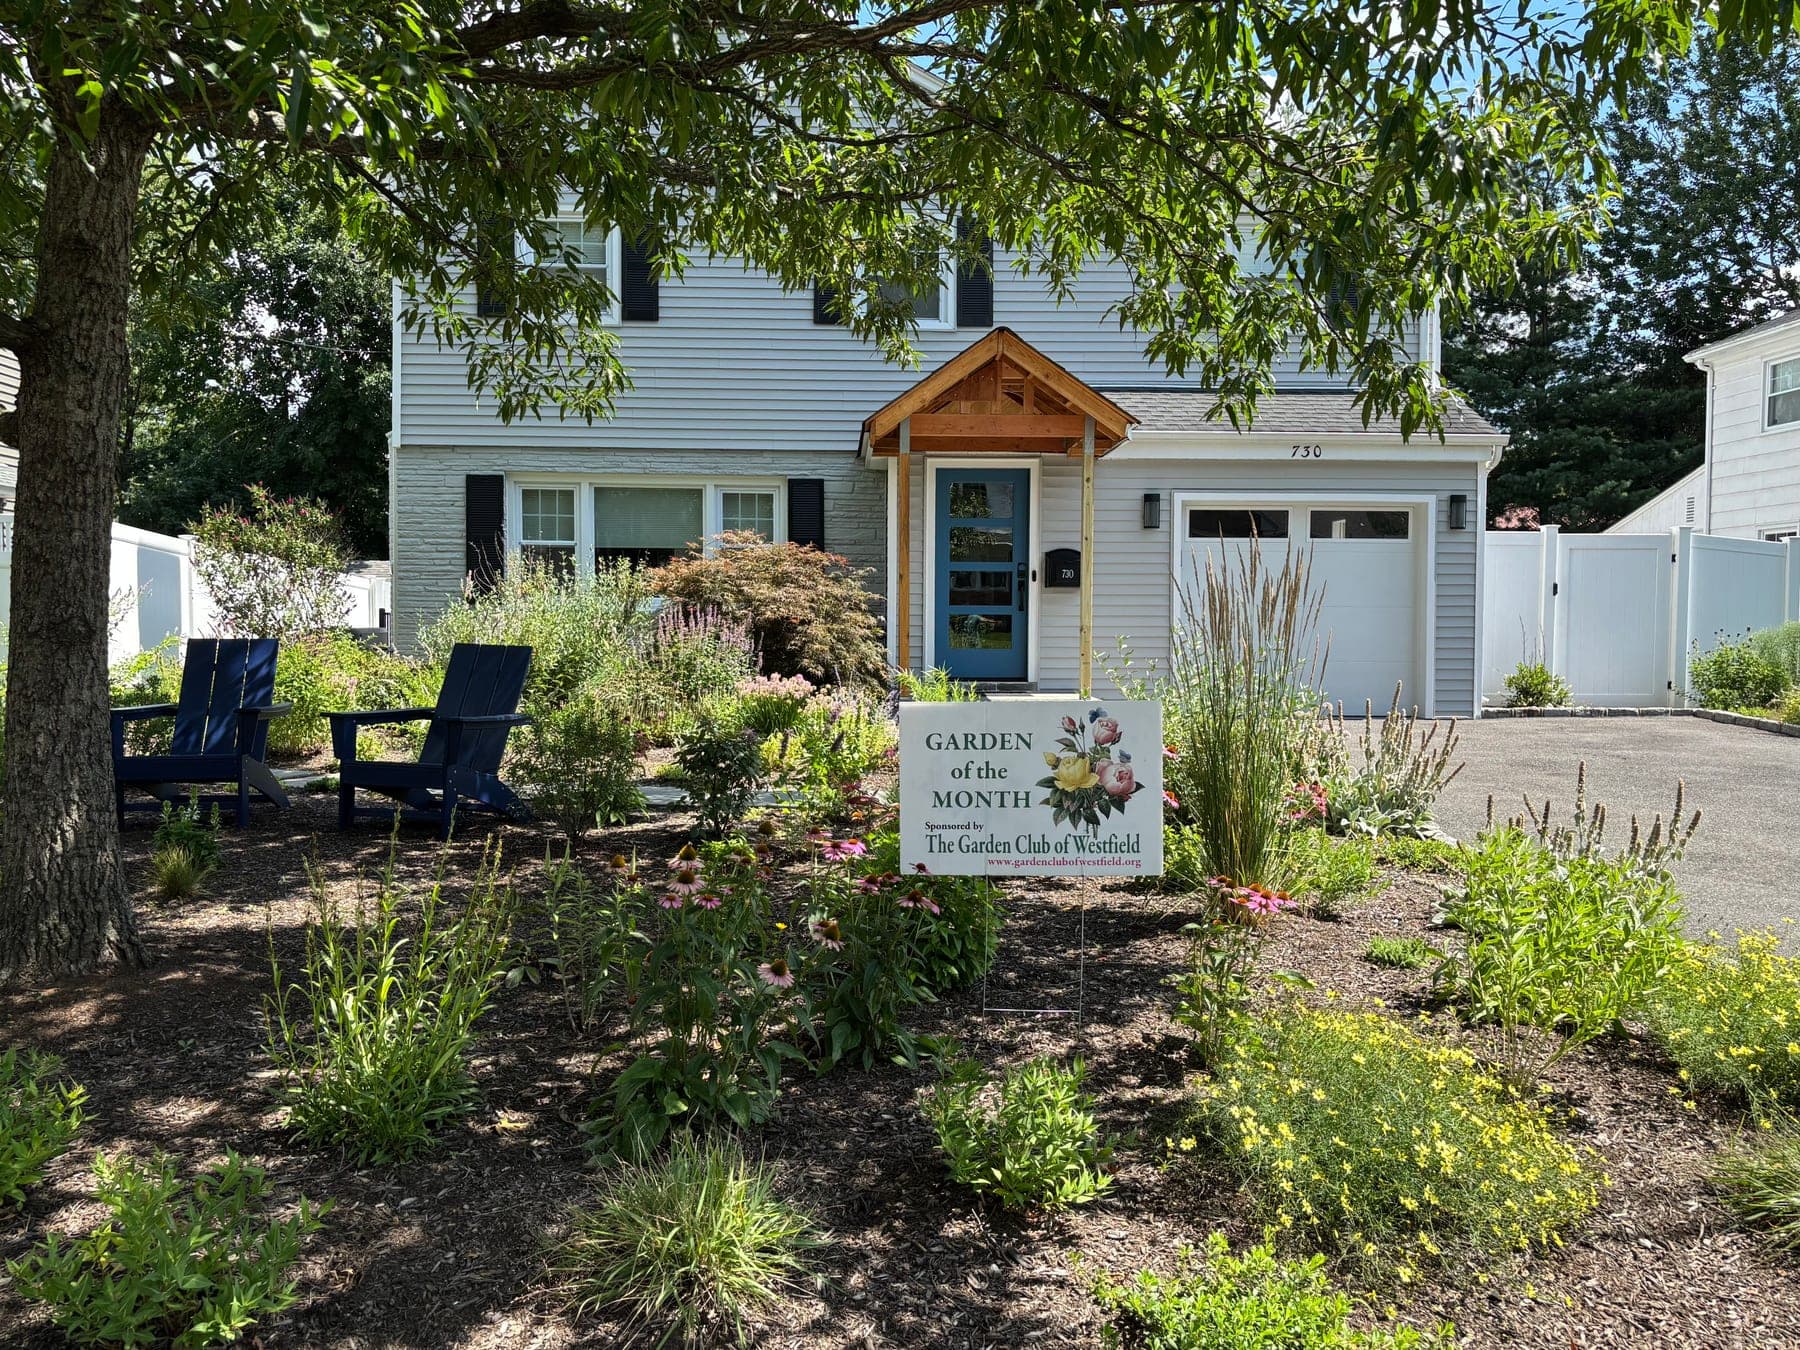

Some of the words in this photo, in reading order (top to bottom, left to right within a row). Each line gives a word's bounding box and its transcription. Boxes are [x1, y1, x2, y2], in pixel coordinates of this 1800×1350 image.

[1291, 445, 1322, 458] 730
[1061, 569, 1074, 579] 730
[925, 732, 1033, 751] GARDEN
[951, 760, 975, 780] of
[976, 760, 1008, 780] the
[931, 790, 1032, 809] MONTH
[925, 821, 971, 832] Sponsored
[973, 821, 984, 833] by
[926, 834, 956, 854] The
[958, 834, 1010, 854] Garden
[1015, 833, 1051, 854] Club
[1054, 833, 1072, 854] of
[1072, 833, 1141, 854] Westfield
[988, 857, 1142, 868] www.gardenclubofwestfield.org
